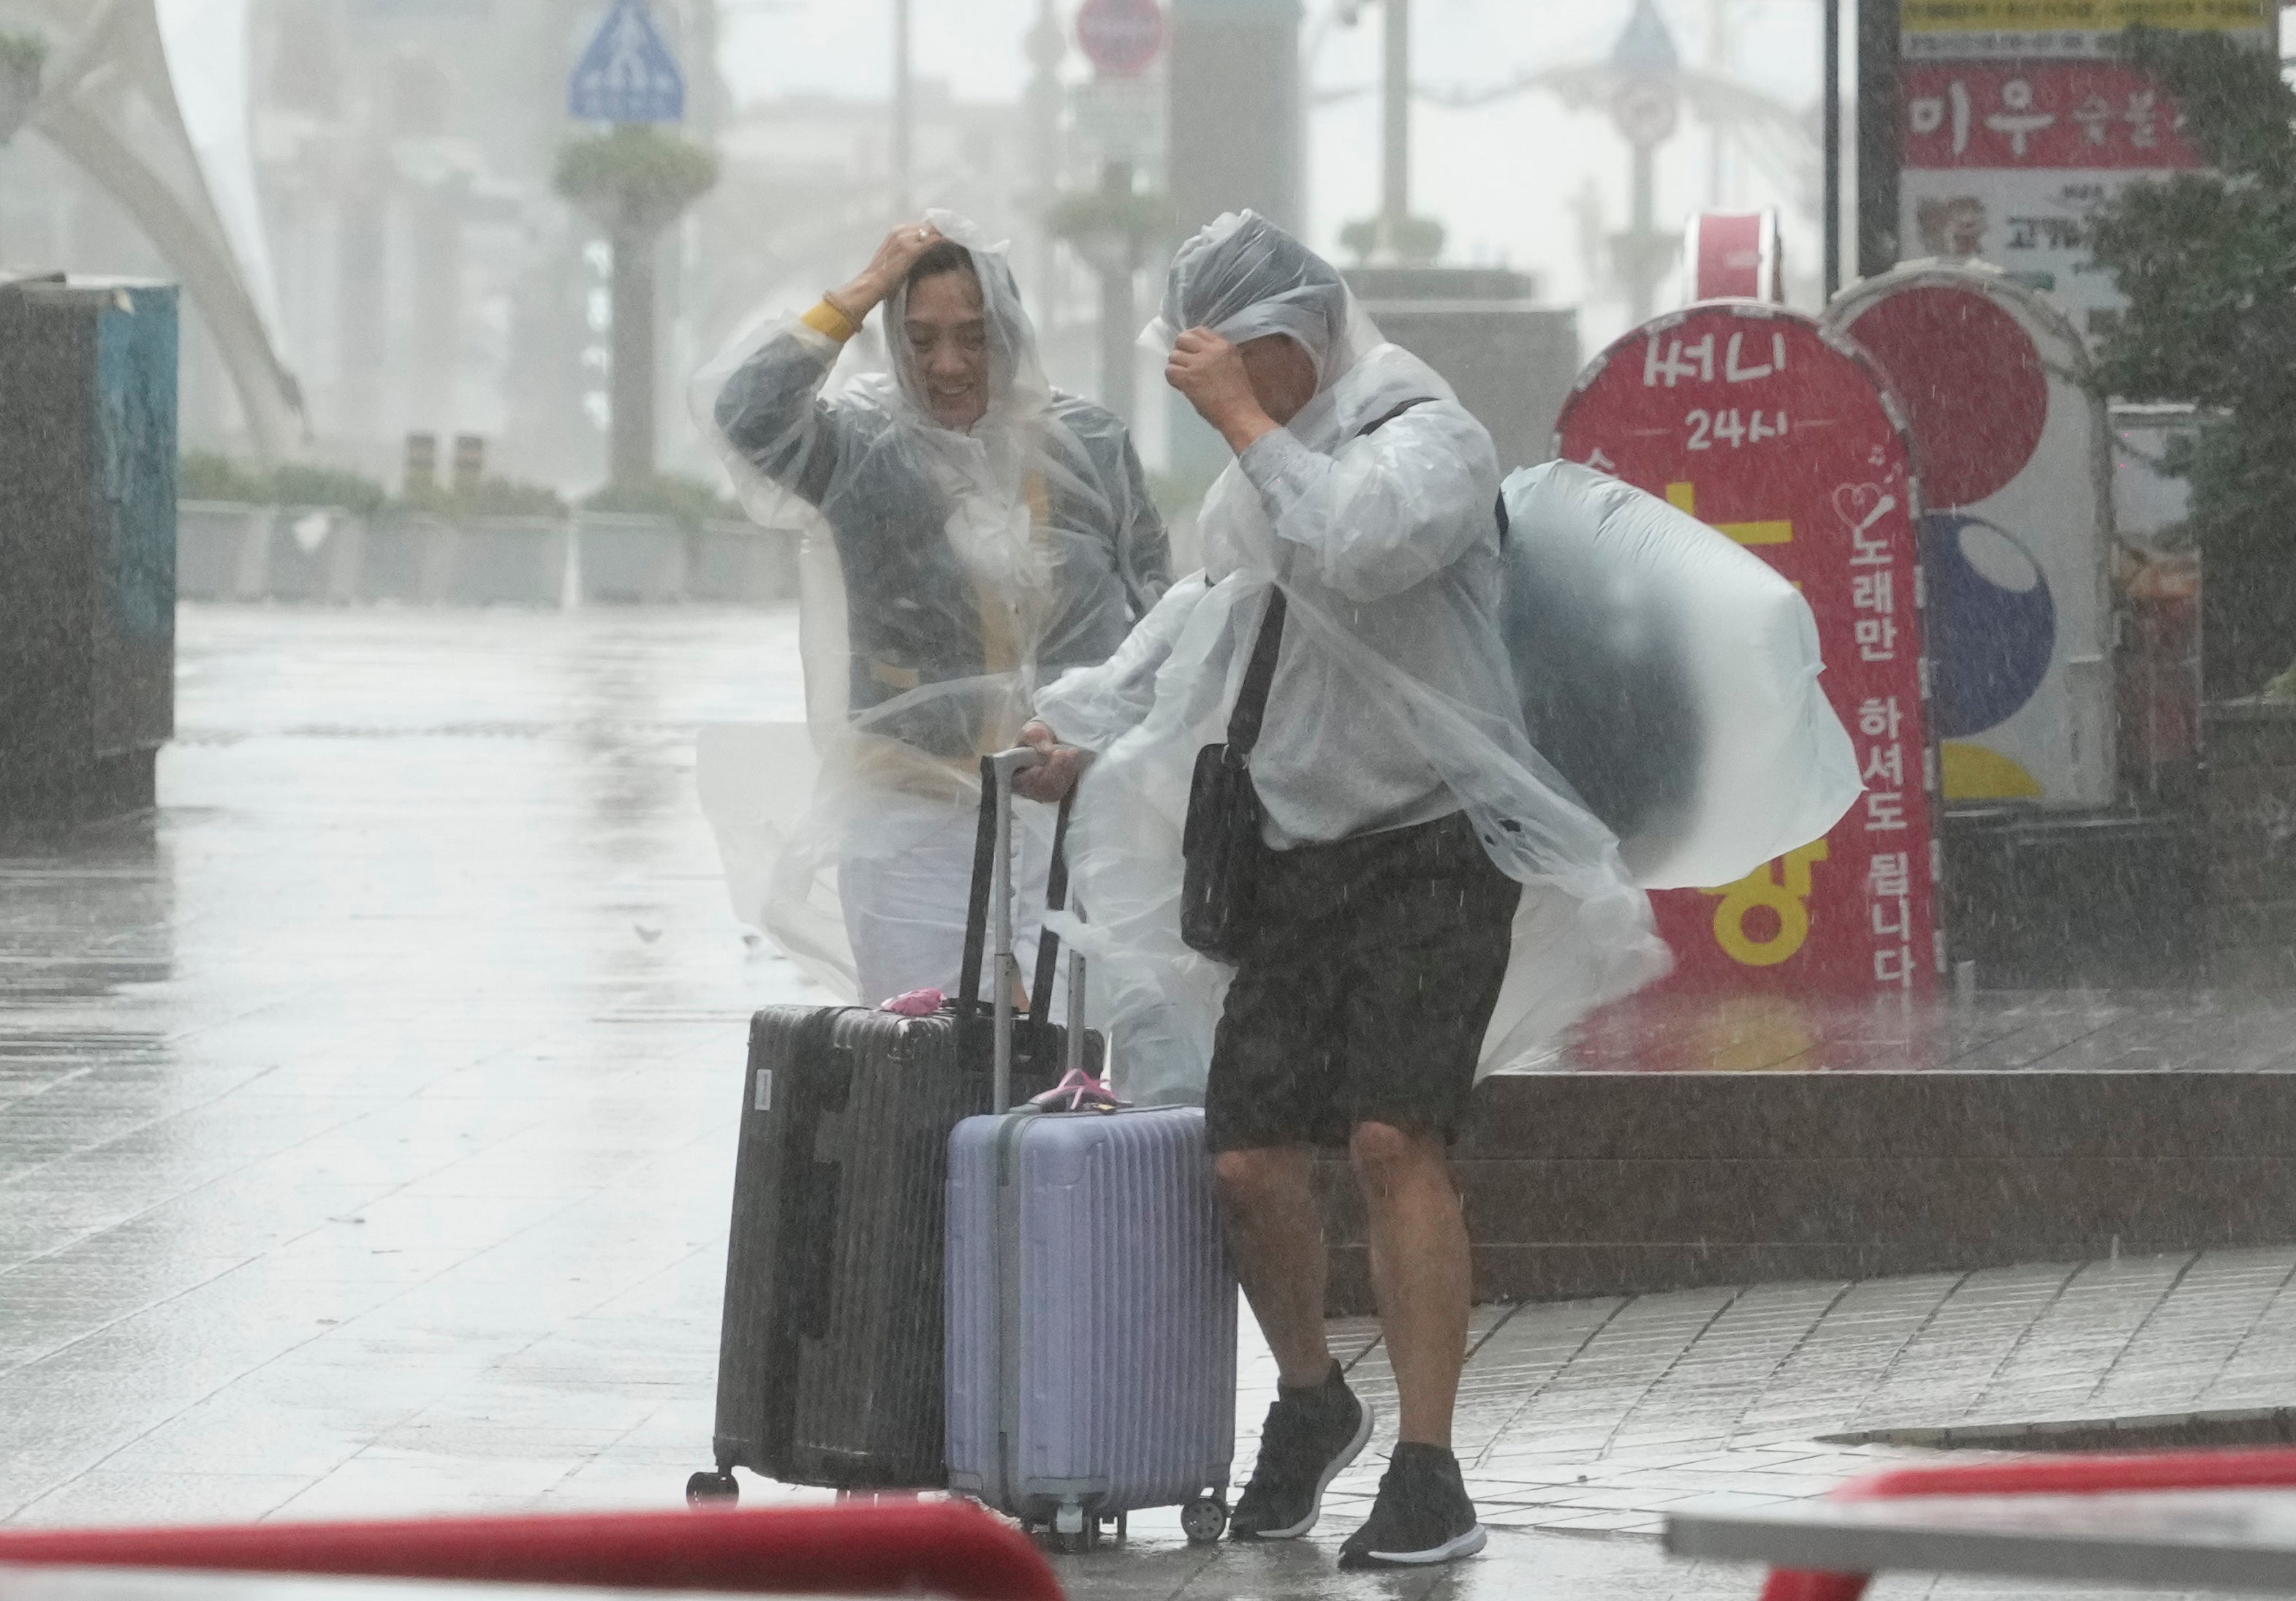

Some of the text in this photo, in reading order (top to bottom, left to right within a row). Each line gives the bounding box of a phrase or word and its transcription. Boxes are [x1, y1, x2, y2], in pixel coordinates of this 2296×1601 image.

[1909, 78, 2056, 156] 미우
[1684, 407, 1789, 451] 24시
[1849, 523, 1917, 988] 노래만 하셔도 됩니다
